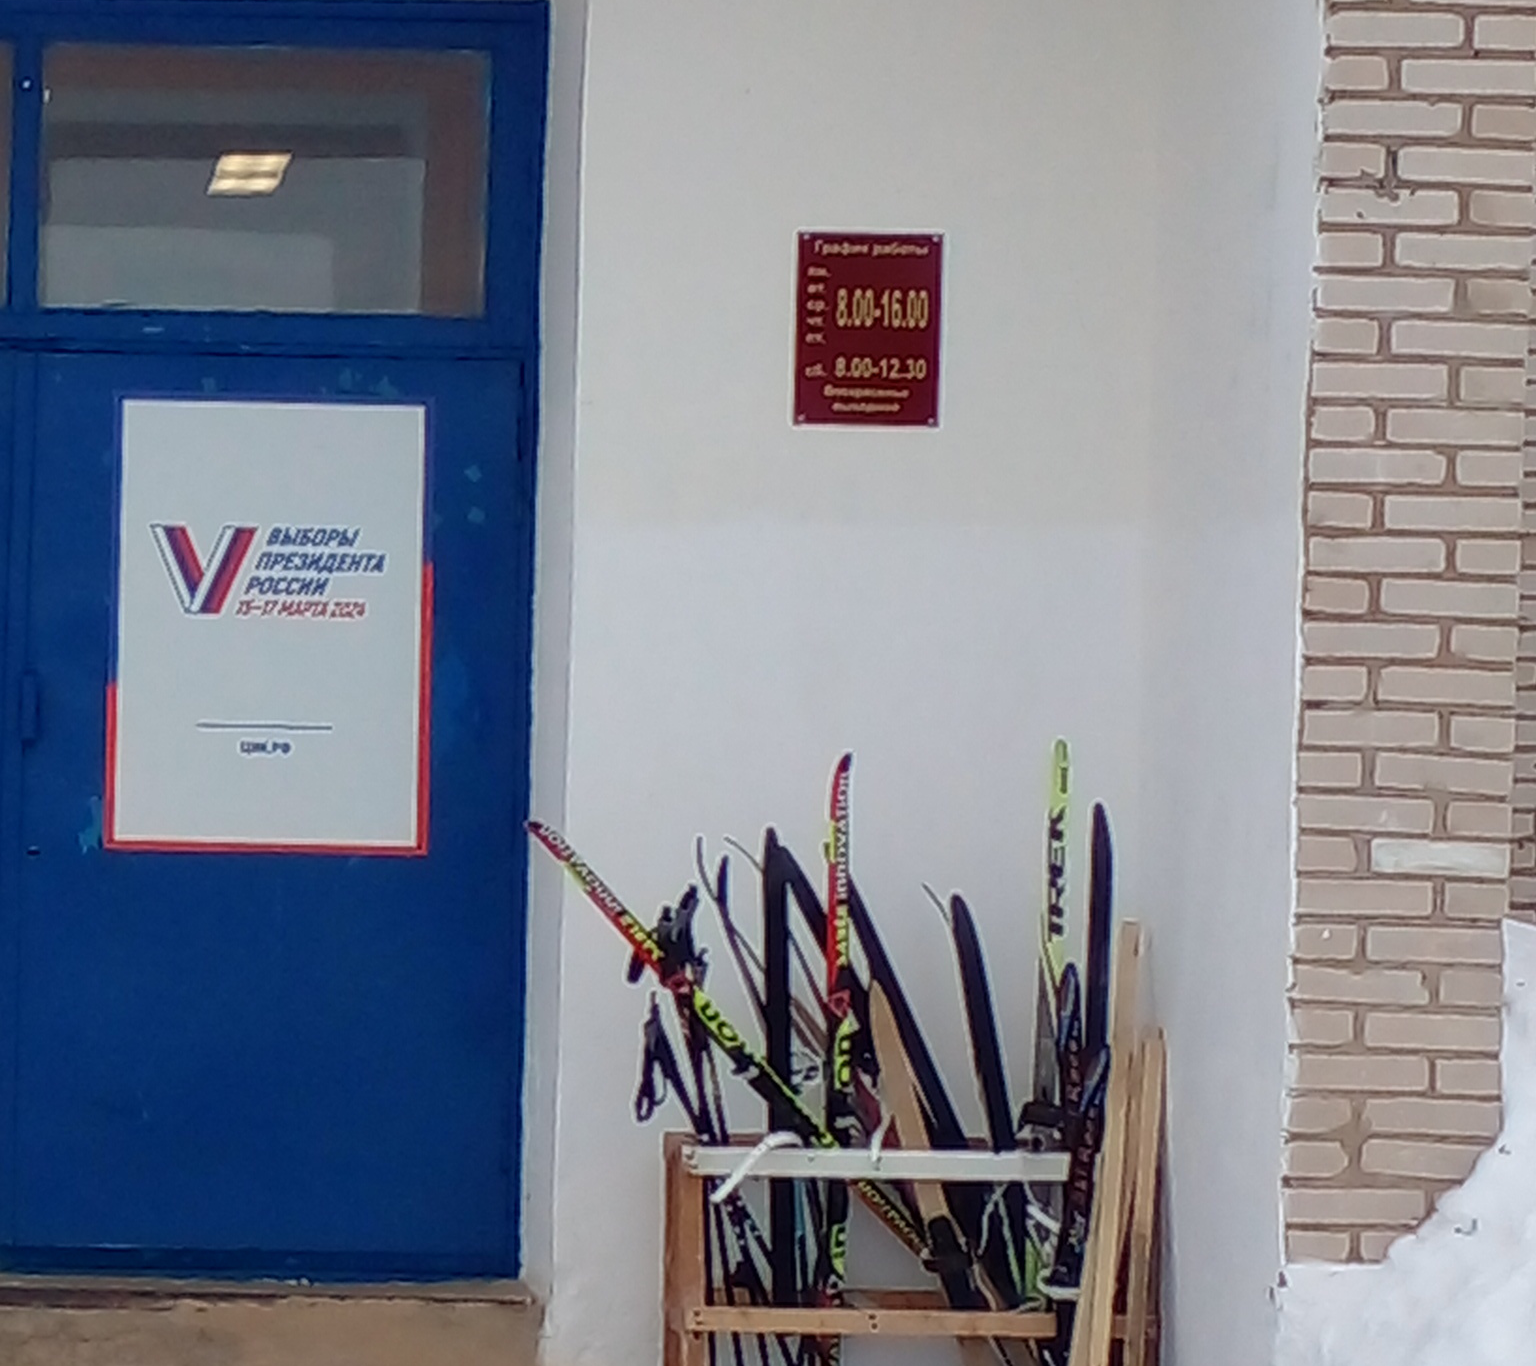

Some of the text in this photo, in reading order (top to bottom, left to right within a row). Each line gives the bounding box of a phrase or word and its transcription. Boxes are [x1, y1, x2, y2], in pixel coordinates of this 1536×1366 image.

[836, 288, 929, 329] 8.00-16.00
[835, 357, 927, 379] 8.00-12.30
[266, 526, 361, 548] ВЫБОРЫ
[255, 551, 386, 574] ПРЕЗИДЕНТА
[244, 576, 330, 595] РОССИИ
[277, 599, 328, 617] МАРТА
